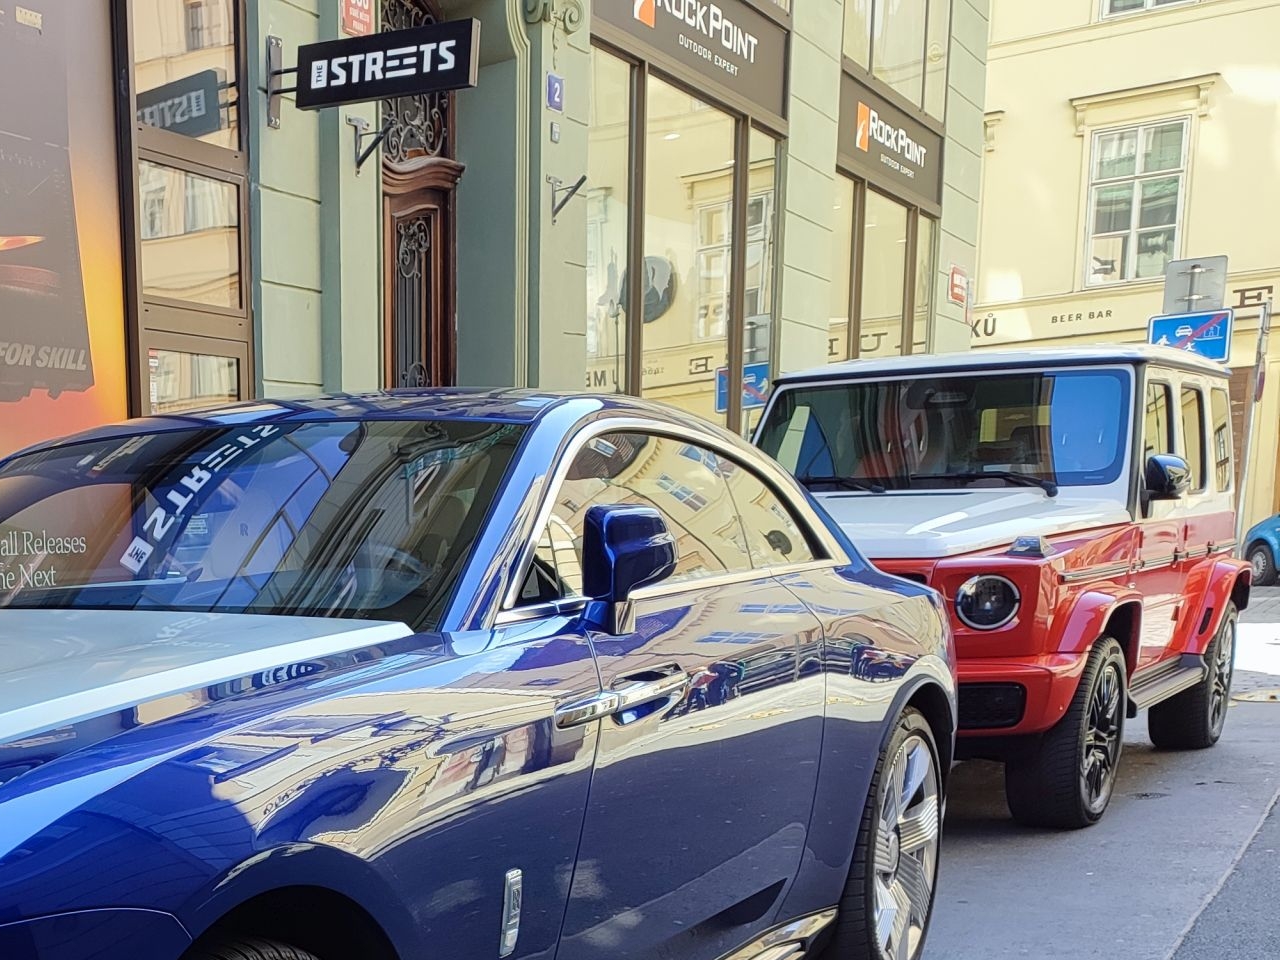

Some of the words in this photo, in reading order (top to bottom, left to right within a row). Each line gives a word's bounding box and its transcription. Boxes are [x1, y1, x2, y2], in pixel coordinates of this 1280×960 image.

[330, 39, 456, 86] STREETS
[679, 34, 712, 61] OUTDOOR
[714, 55, 739, 76] EXPERT
[554, 82, 561, 103] 2
[1051, 313, 1083, 324] BEER
[1088, 309, 1113, 320] BAR
[35, 346, 87, 371] SKILL
[22, 530, 86, 555] Releases
[19, 563, 57, 588] Next
